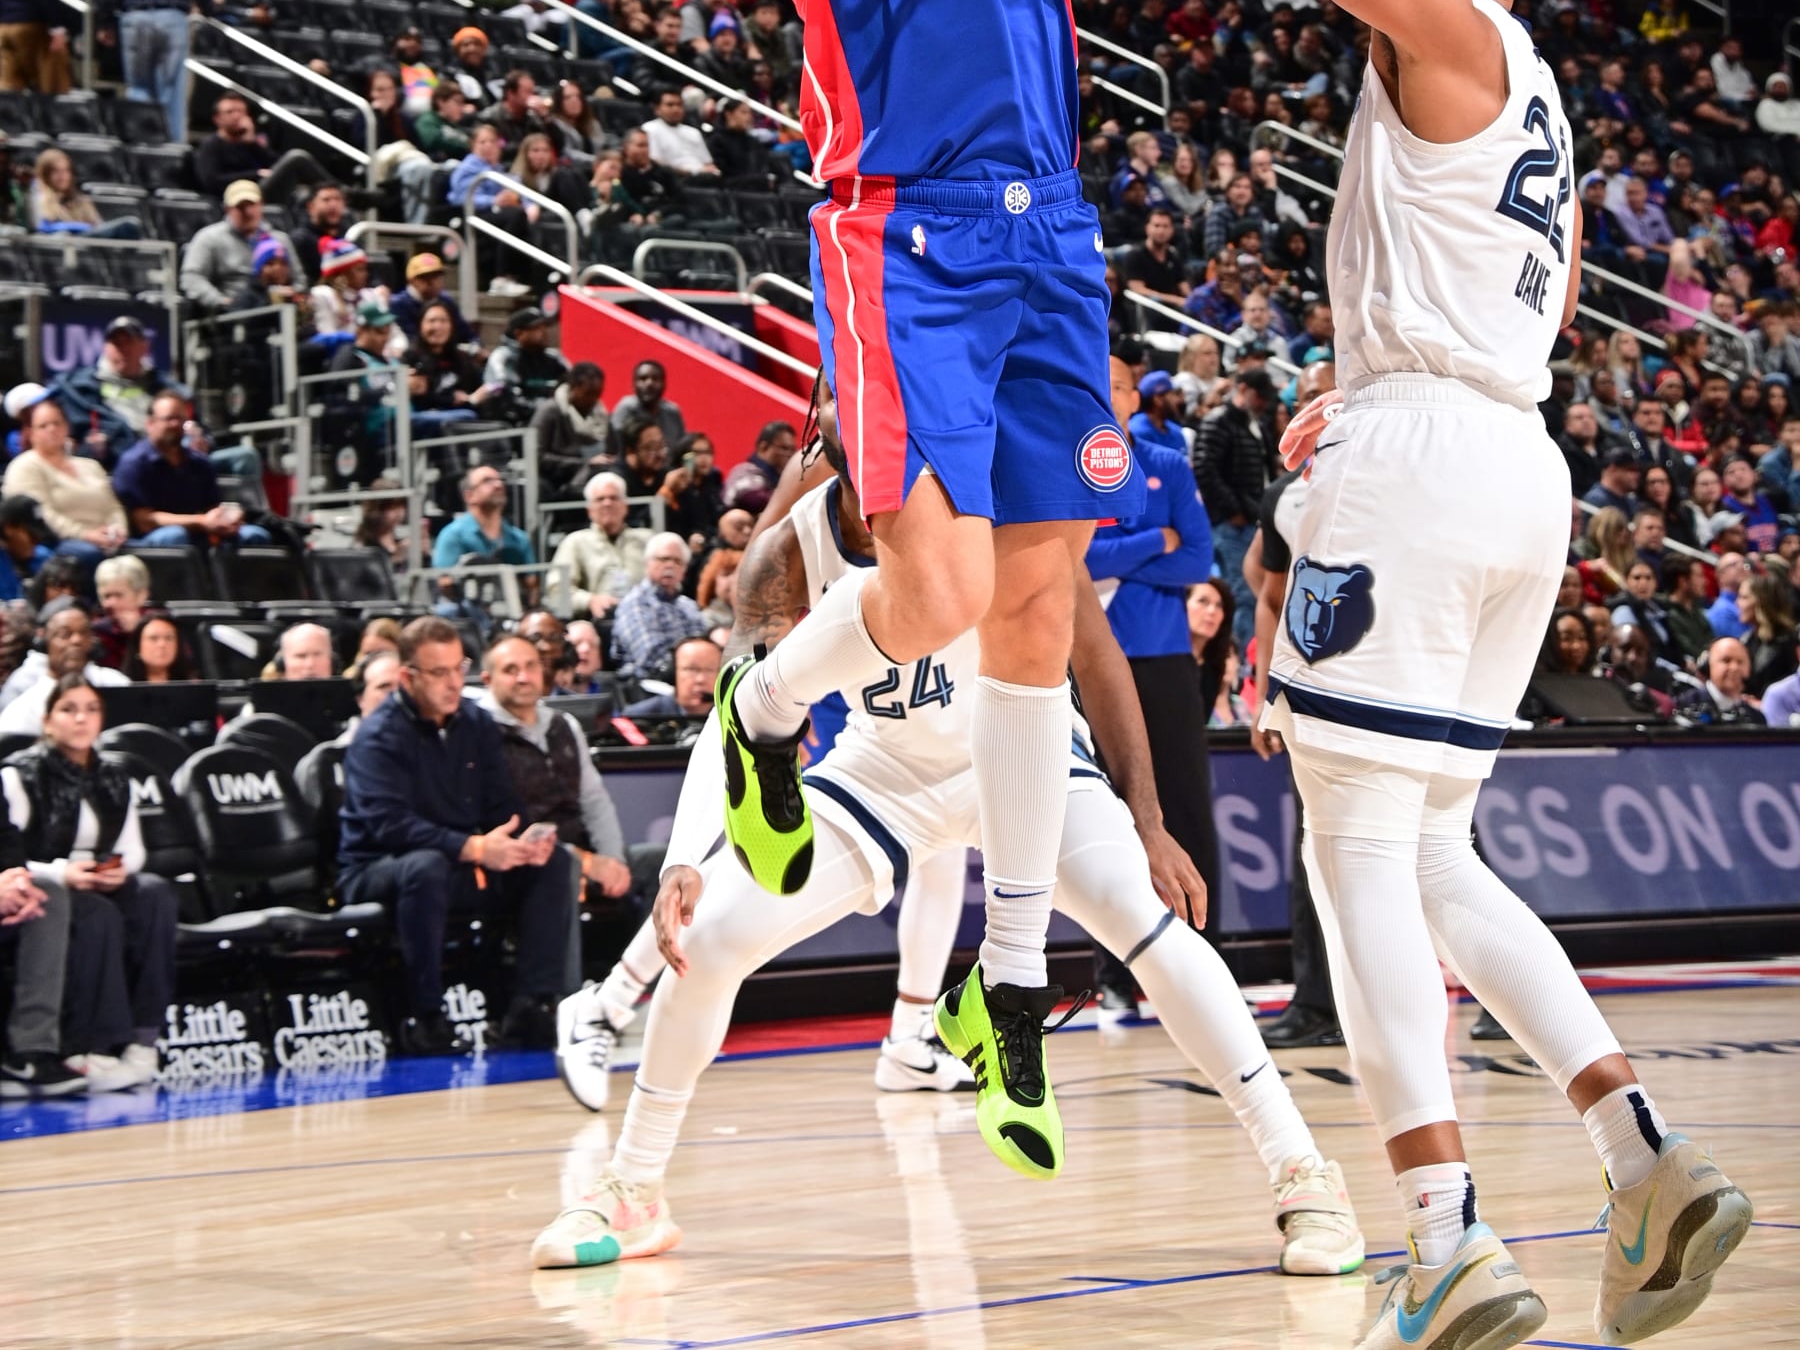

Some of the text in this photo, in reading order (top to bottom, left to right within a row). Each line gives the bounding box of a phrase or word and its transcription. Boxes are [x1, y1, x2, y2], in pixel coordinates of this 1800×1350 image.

[1514, 250, 1552, 316] BANE
[1089, 458, 1124, 469] PISTONS
[1090, 447, 1123, 458] DETROIT
[862, 653, 955, 720] 24
[207, 770, 283, 804] UWM
[1601, 783, 1733, 877] ON
[1740, 781, 1800, 870] O
[166, 1001, 247, 1046] Little
[288, 991, 369, 1034] Little
[274, 1027, 387, 1069] Caesars
